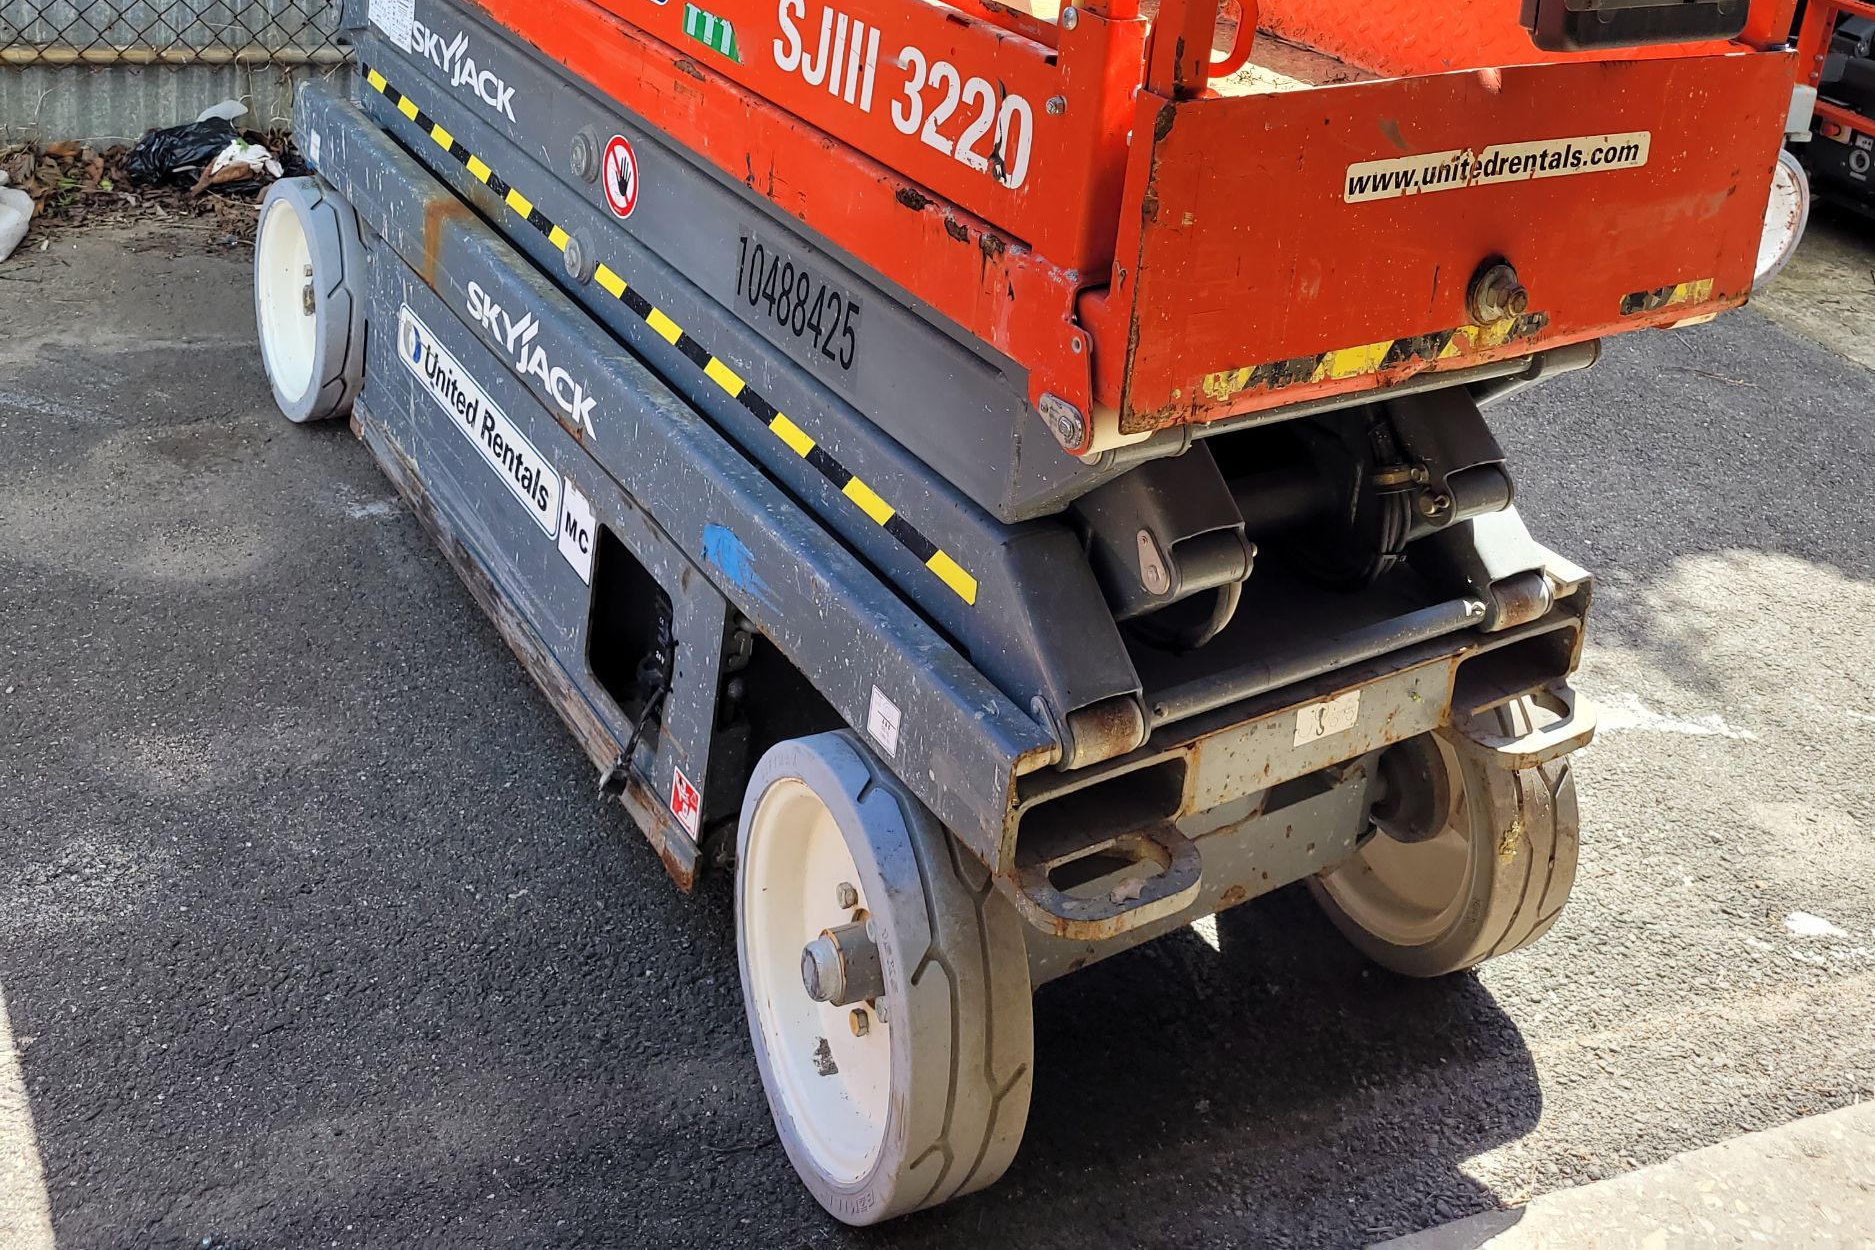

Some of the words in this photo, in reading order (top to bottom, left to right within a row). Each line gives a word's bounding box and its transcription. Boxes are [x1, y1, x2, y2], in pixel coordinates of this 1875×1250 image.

[411, 20, 516, 123] SKYJACK
[891, 46, 1033, 190] 3220
[1348, 141, 1640, 196] www.unitedrentals.com
[466, 281, 597, 441] SKYJACK
[736, 236, 860, 371] 10488425
[424, 344, 478, 429] United
[480, 408, 549, 513] Rentals
[565, 513, 589, 555] MC
